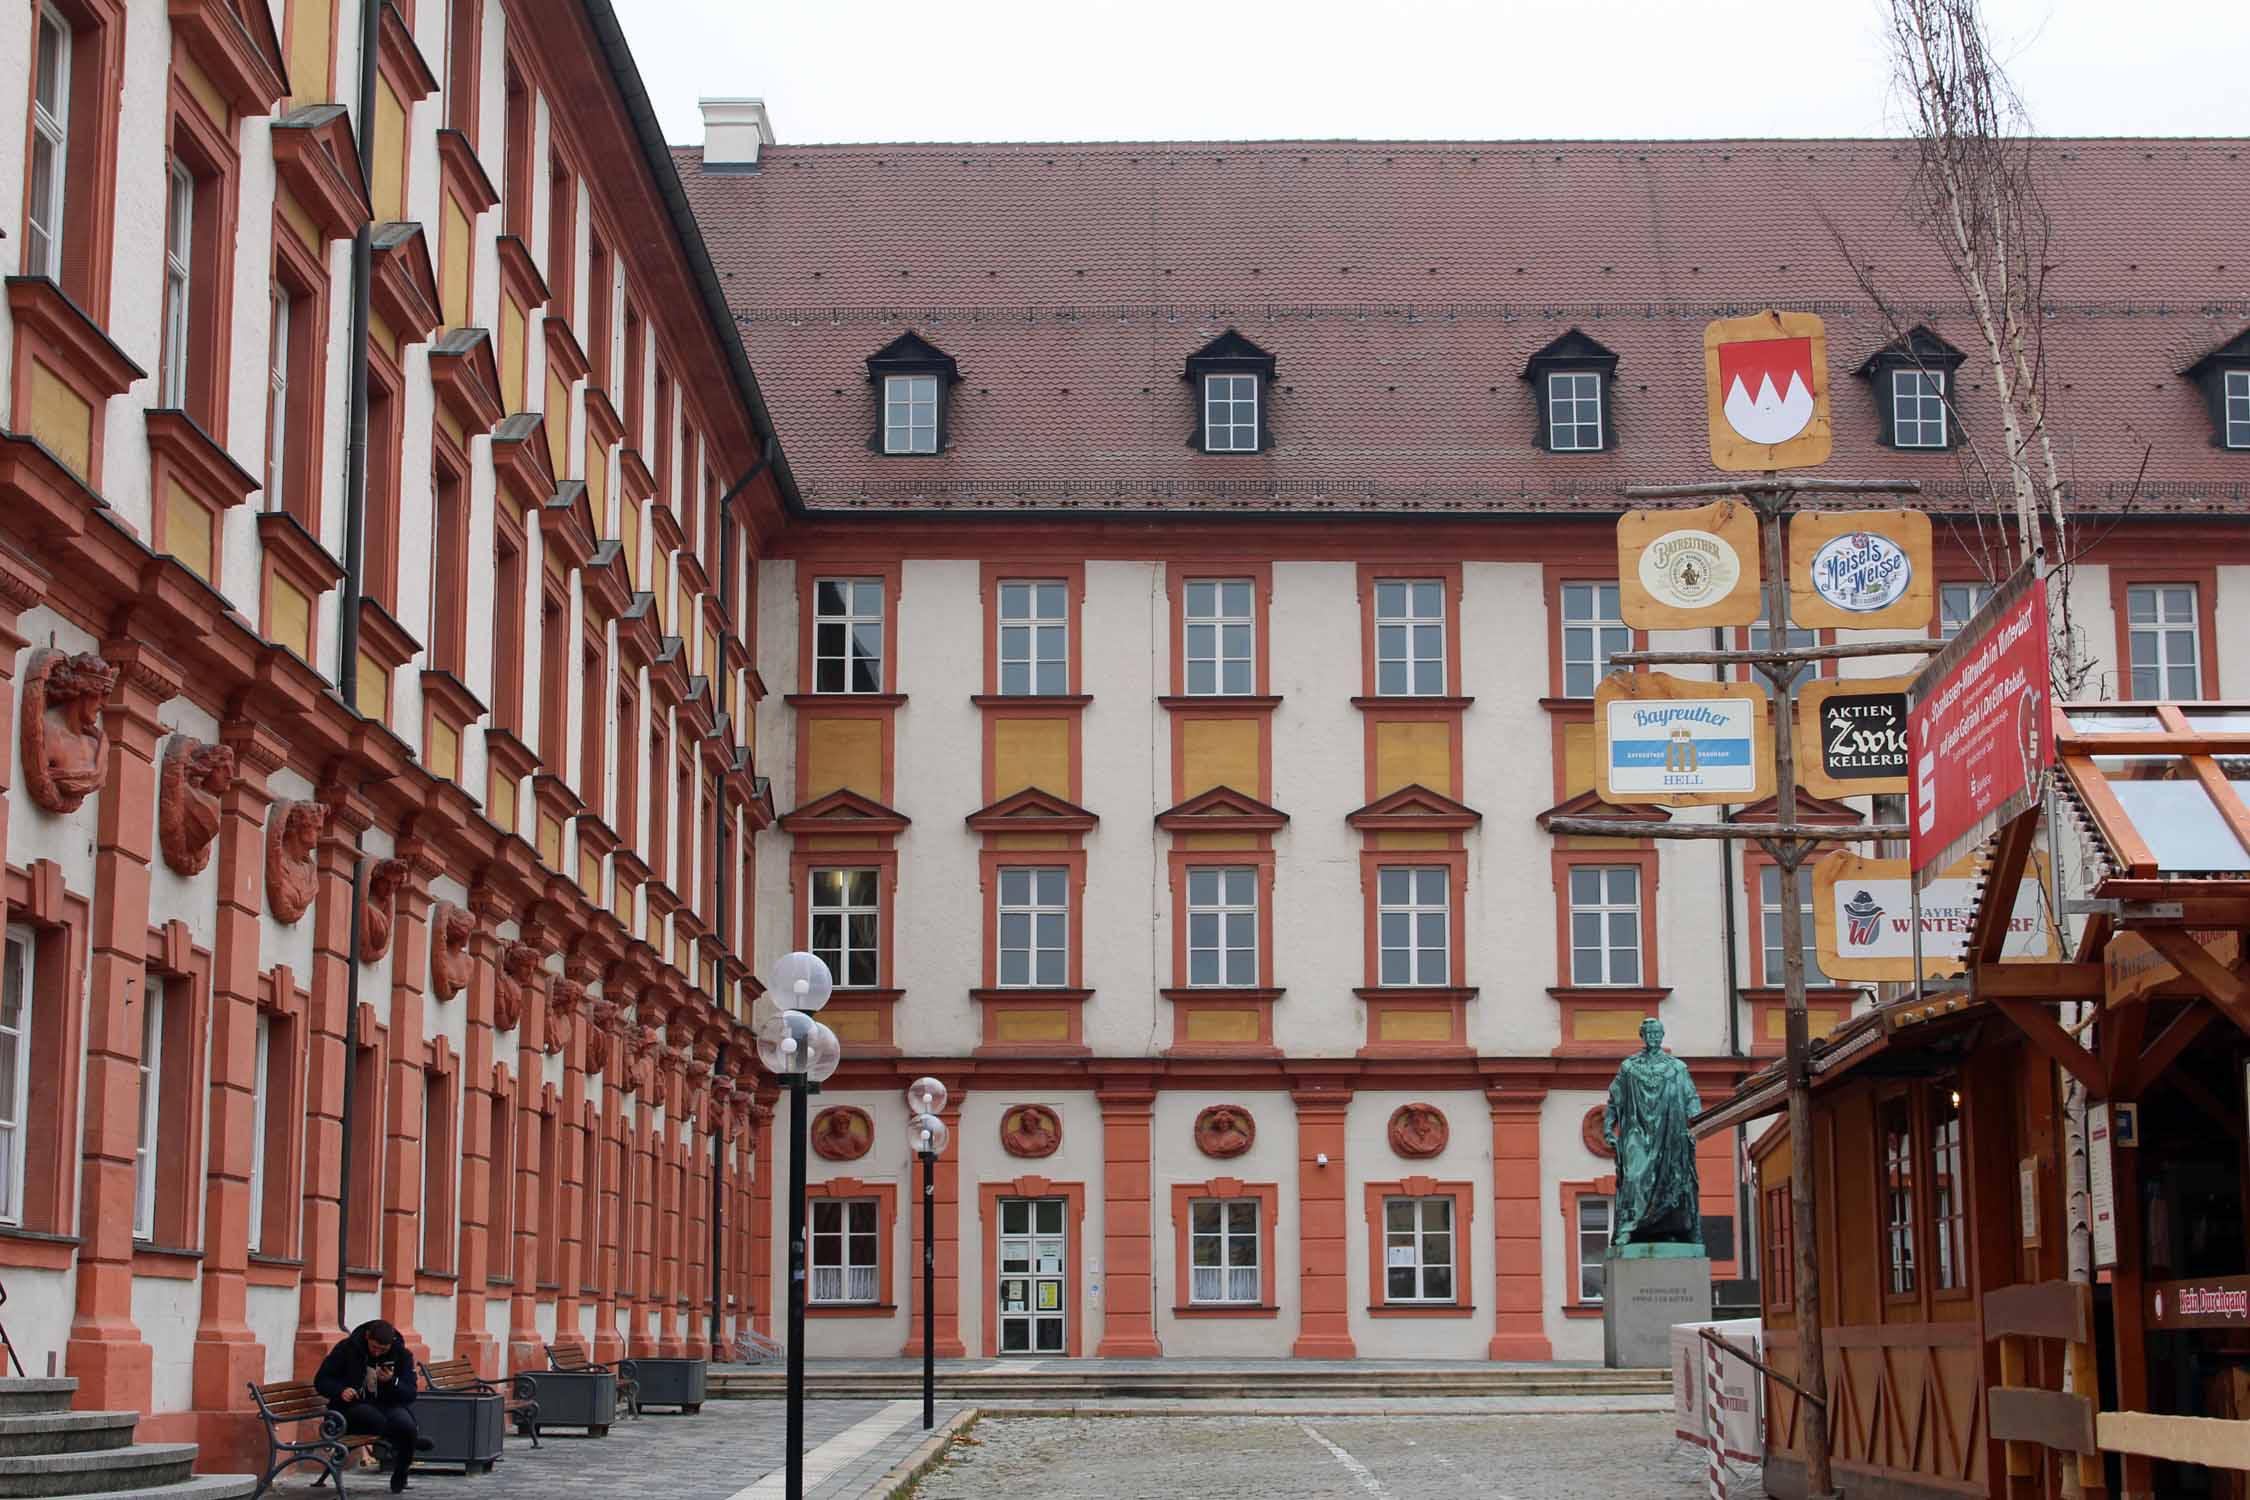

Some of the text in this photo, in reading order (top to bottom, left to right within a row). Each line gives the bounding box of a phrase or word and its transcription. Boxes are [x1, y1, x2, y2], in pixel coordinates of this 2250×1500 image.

[1822, 539, 1881, 592] Maisel's
[1848, 554, 1900, 593] Weisse
[1633, 706, 1730, 728] Bayreuther
[1828, 705, 1893, 718] AKTIEN
[1828, 717, 1907, 755] Zwic
[2179, 1286, 2247, 1319] Kein Durchgang
